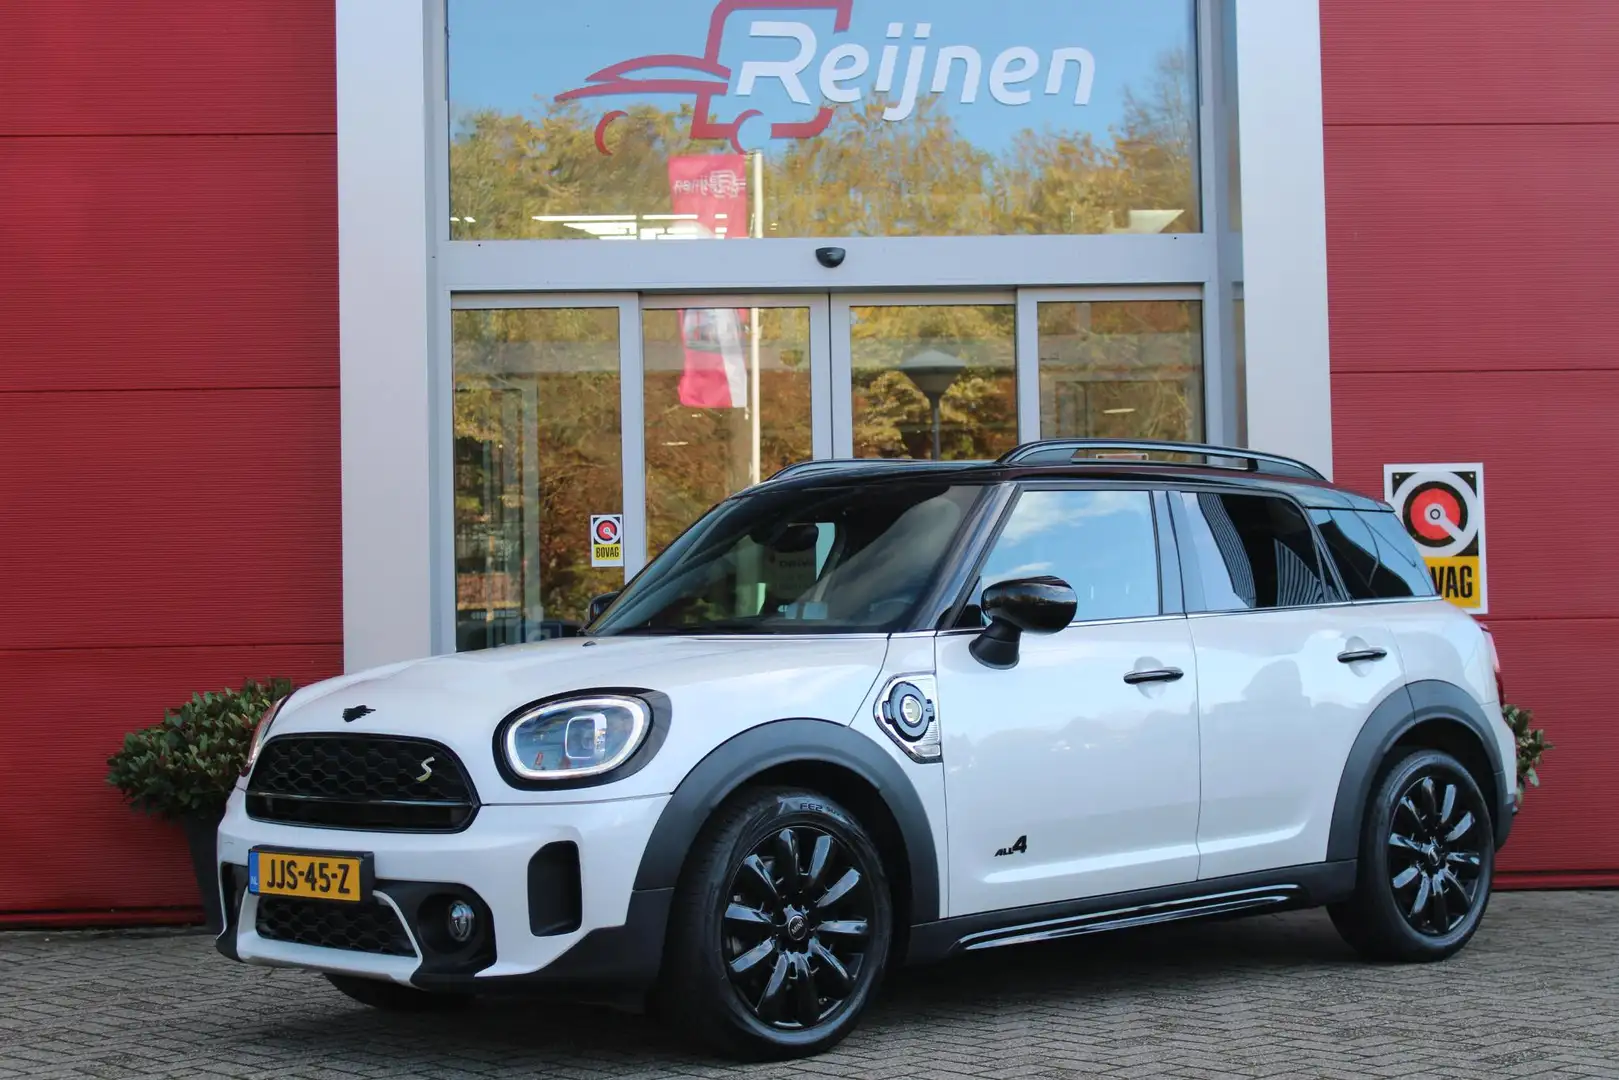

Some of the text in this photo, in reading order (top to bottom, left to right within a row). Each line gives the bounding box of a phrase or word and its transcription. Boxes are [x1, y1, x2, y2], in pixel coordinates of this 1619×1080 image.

[735, 20, 1096, 122] Reijnen
[596, 547, 619, 558] BOVAG
[1430, 565, 1473, 598] VAG
[267, 858, 351, 894] JJS-45-Z
